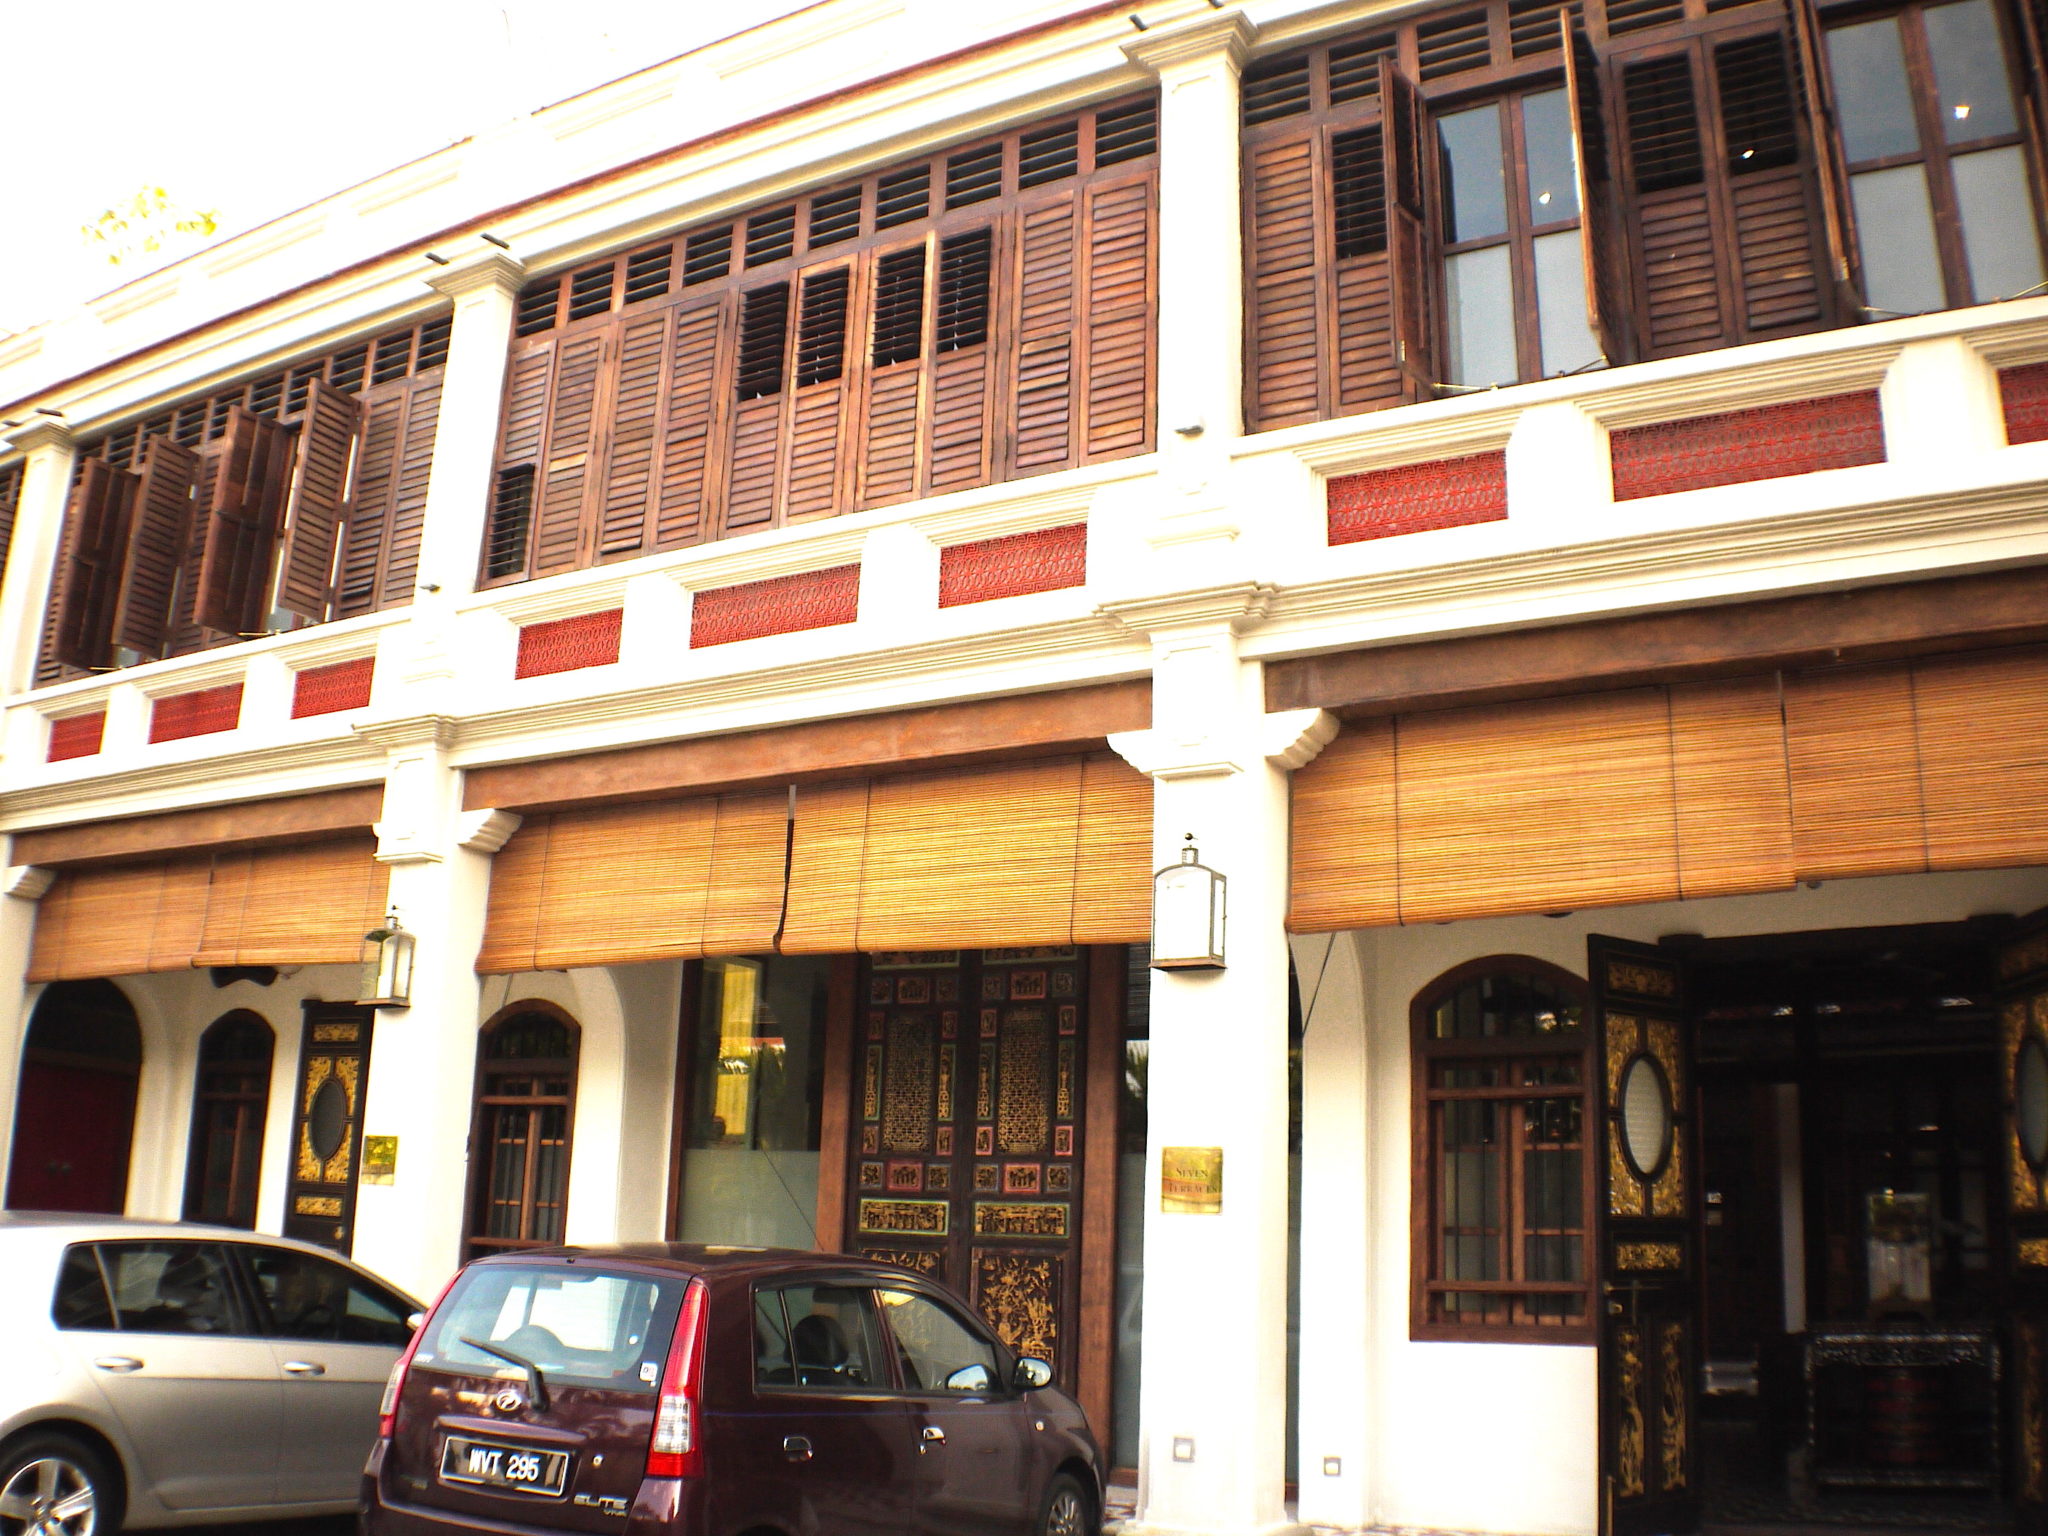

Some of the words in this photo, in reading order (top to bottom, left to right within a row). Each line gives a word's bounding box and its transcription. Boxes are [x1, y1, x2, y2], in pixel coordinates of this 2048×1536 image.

[468, 1448, 503, 1475] WVT
[506, 1454, 540, 1482] 295
[573, 1494, 628, 1510] ELITE
